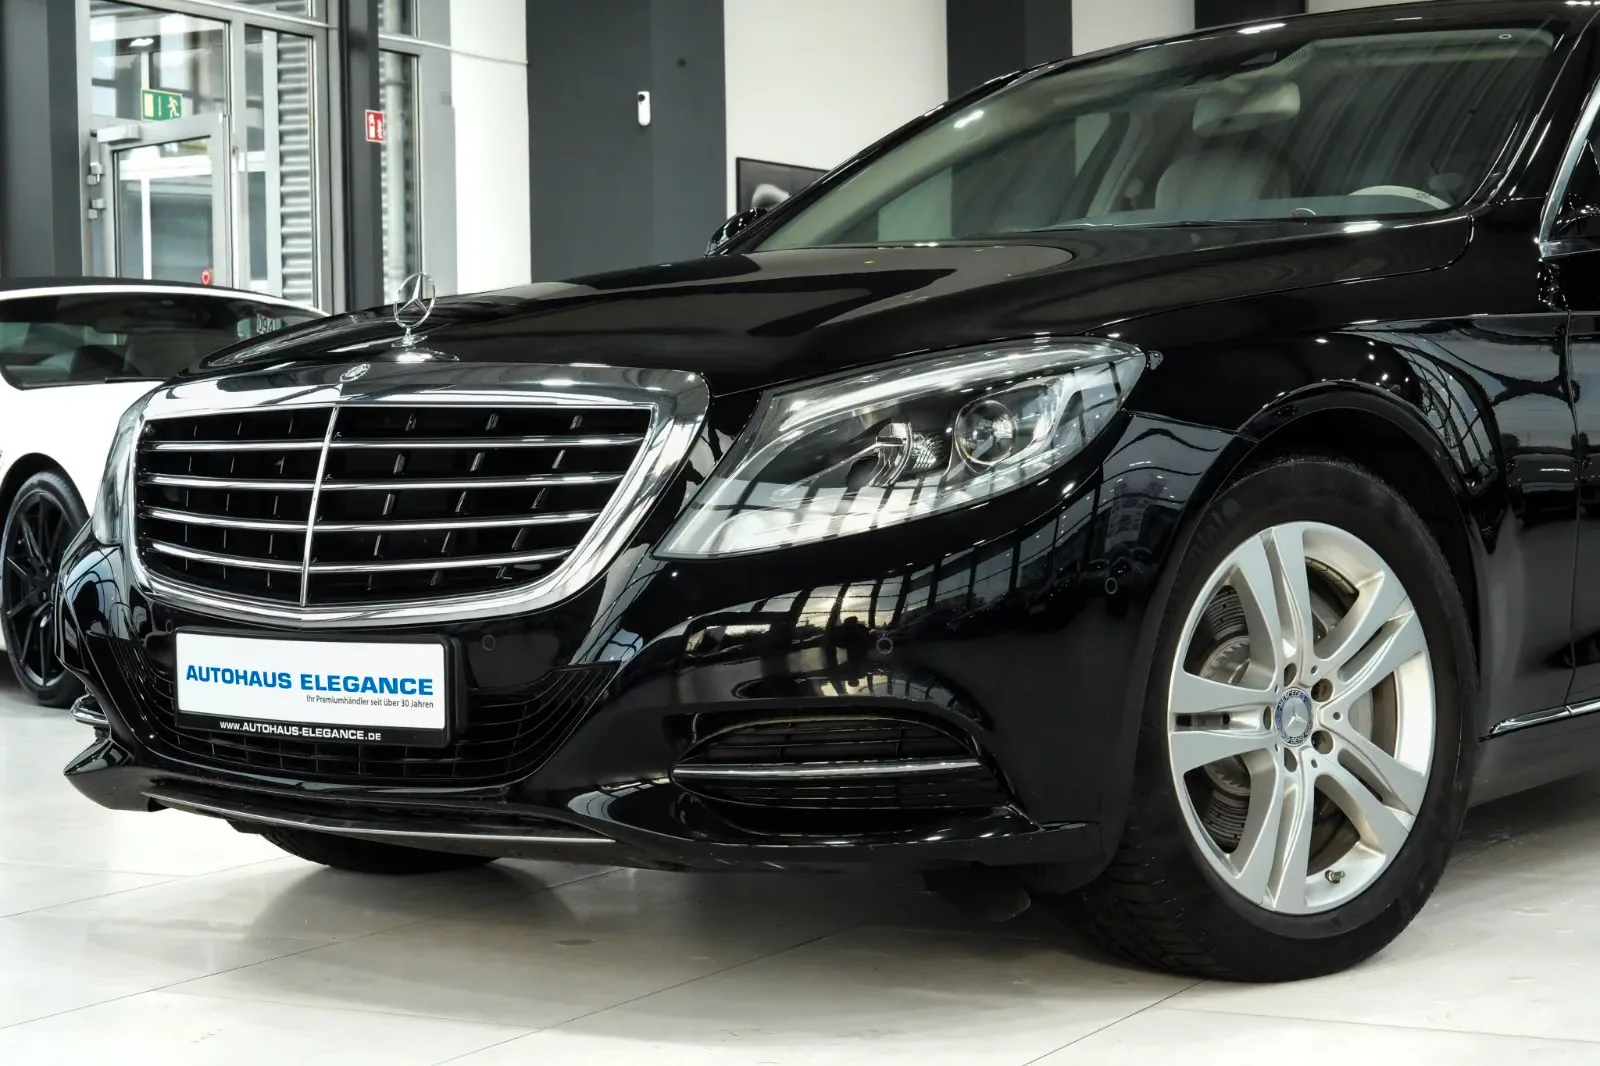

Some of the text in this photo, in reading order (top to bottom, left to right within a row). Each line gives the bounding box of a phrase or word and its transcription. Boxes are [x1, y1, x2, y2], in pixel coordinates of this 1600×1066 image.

[186, 665, 433, 695] AUTOHAUS ELEGANCE
[316, 695, 369, 706] Premiumhändler
[370, 698, 382, 706] seit
[383, 698, 399, 707] über
[401, 699, 410, 707] 30
[410, 699, 434, 708] Jahren
